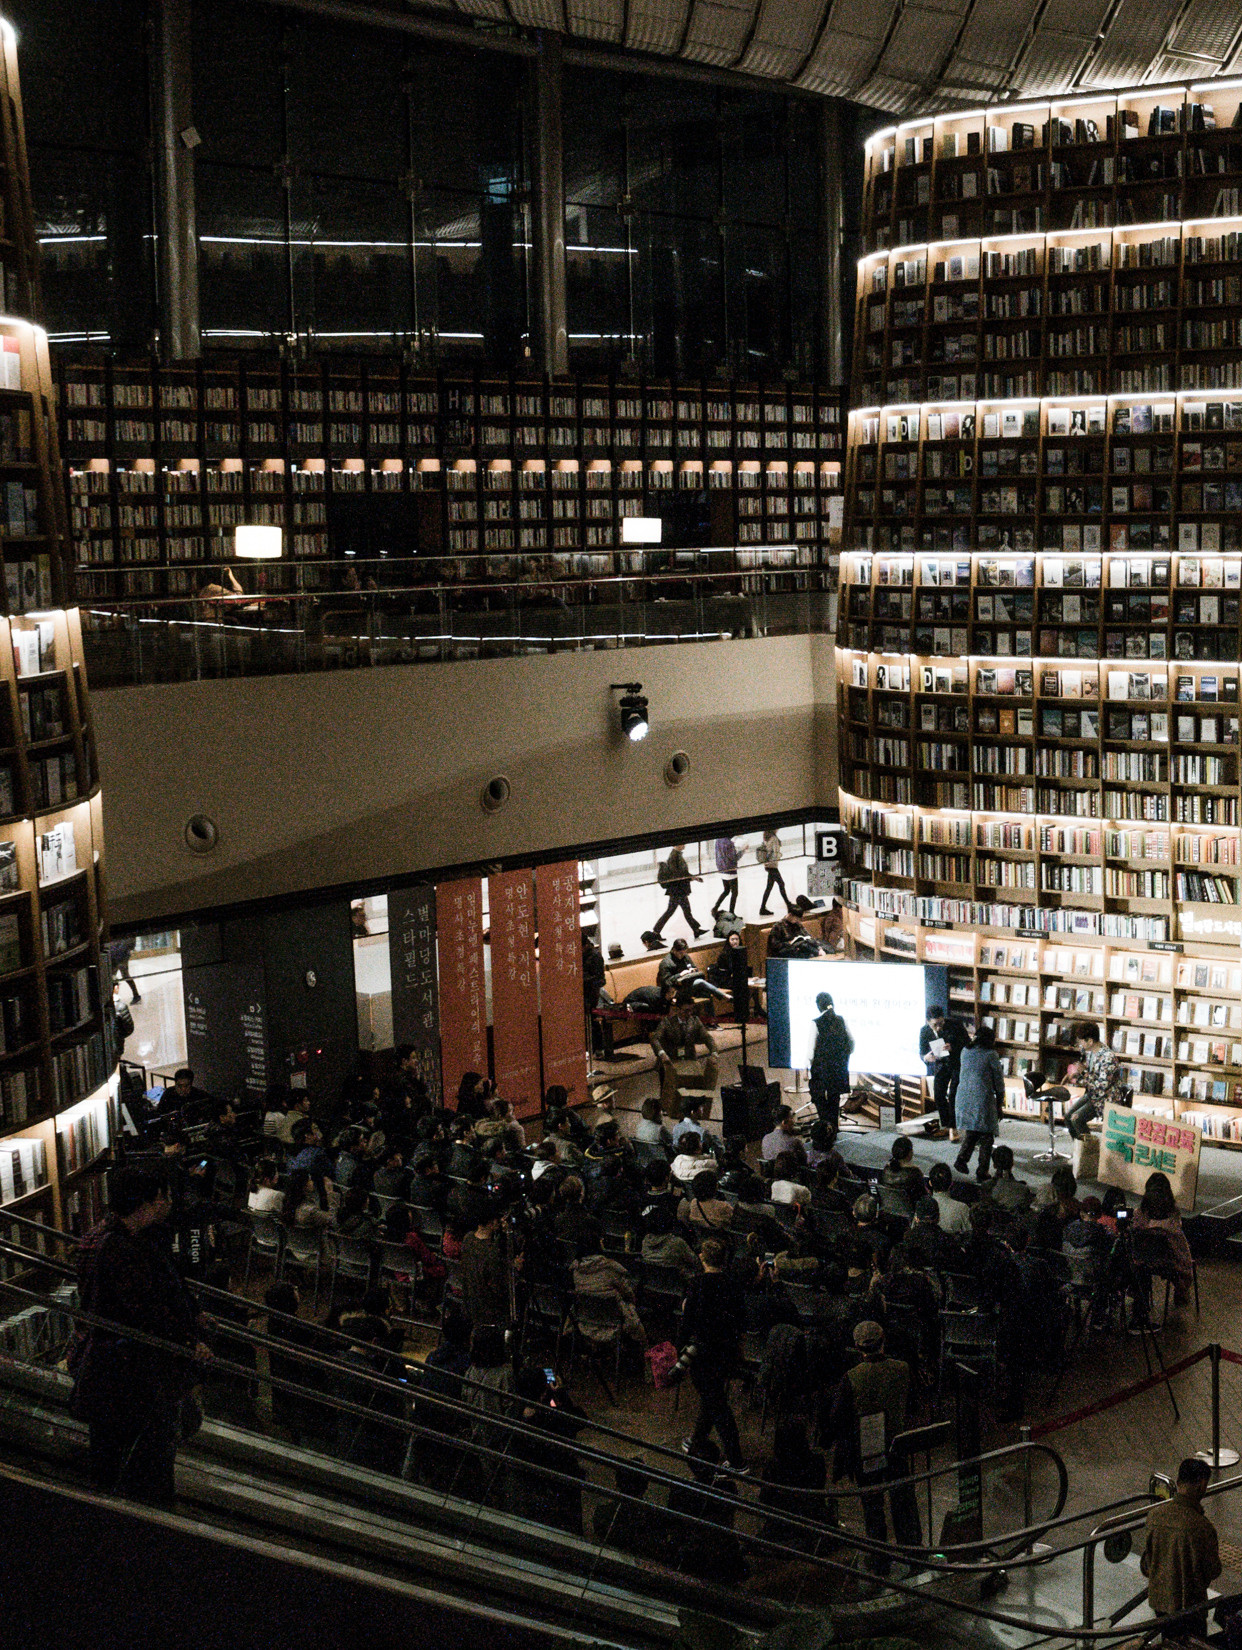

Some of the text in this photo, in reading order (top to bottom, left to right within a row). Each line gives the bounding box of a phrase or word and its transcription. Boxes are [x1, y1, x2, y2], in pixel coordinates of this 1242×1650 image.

[448, 389, 460, 410] H
[822, 836, 838, 858] B
[563, 875, 576, 931] 공지영
[402, 908, 419, 989] 스타필드
[516, 883, 531, 987] 안도현 시인
[418, 904, 434, 1029] 별마당도서관
[1105, 1109, 1196, 1163] 북 환경교육
[1135, 1144, 1177, 1174] 콘서트
[190, 1229, 201, 1264] Fiction
